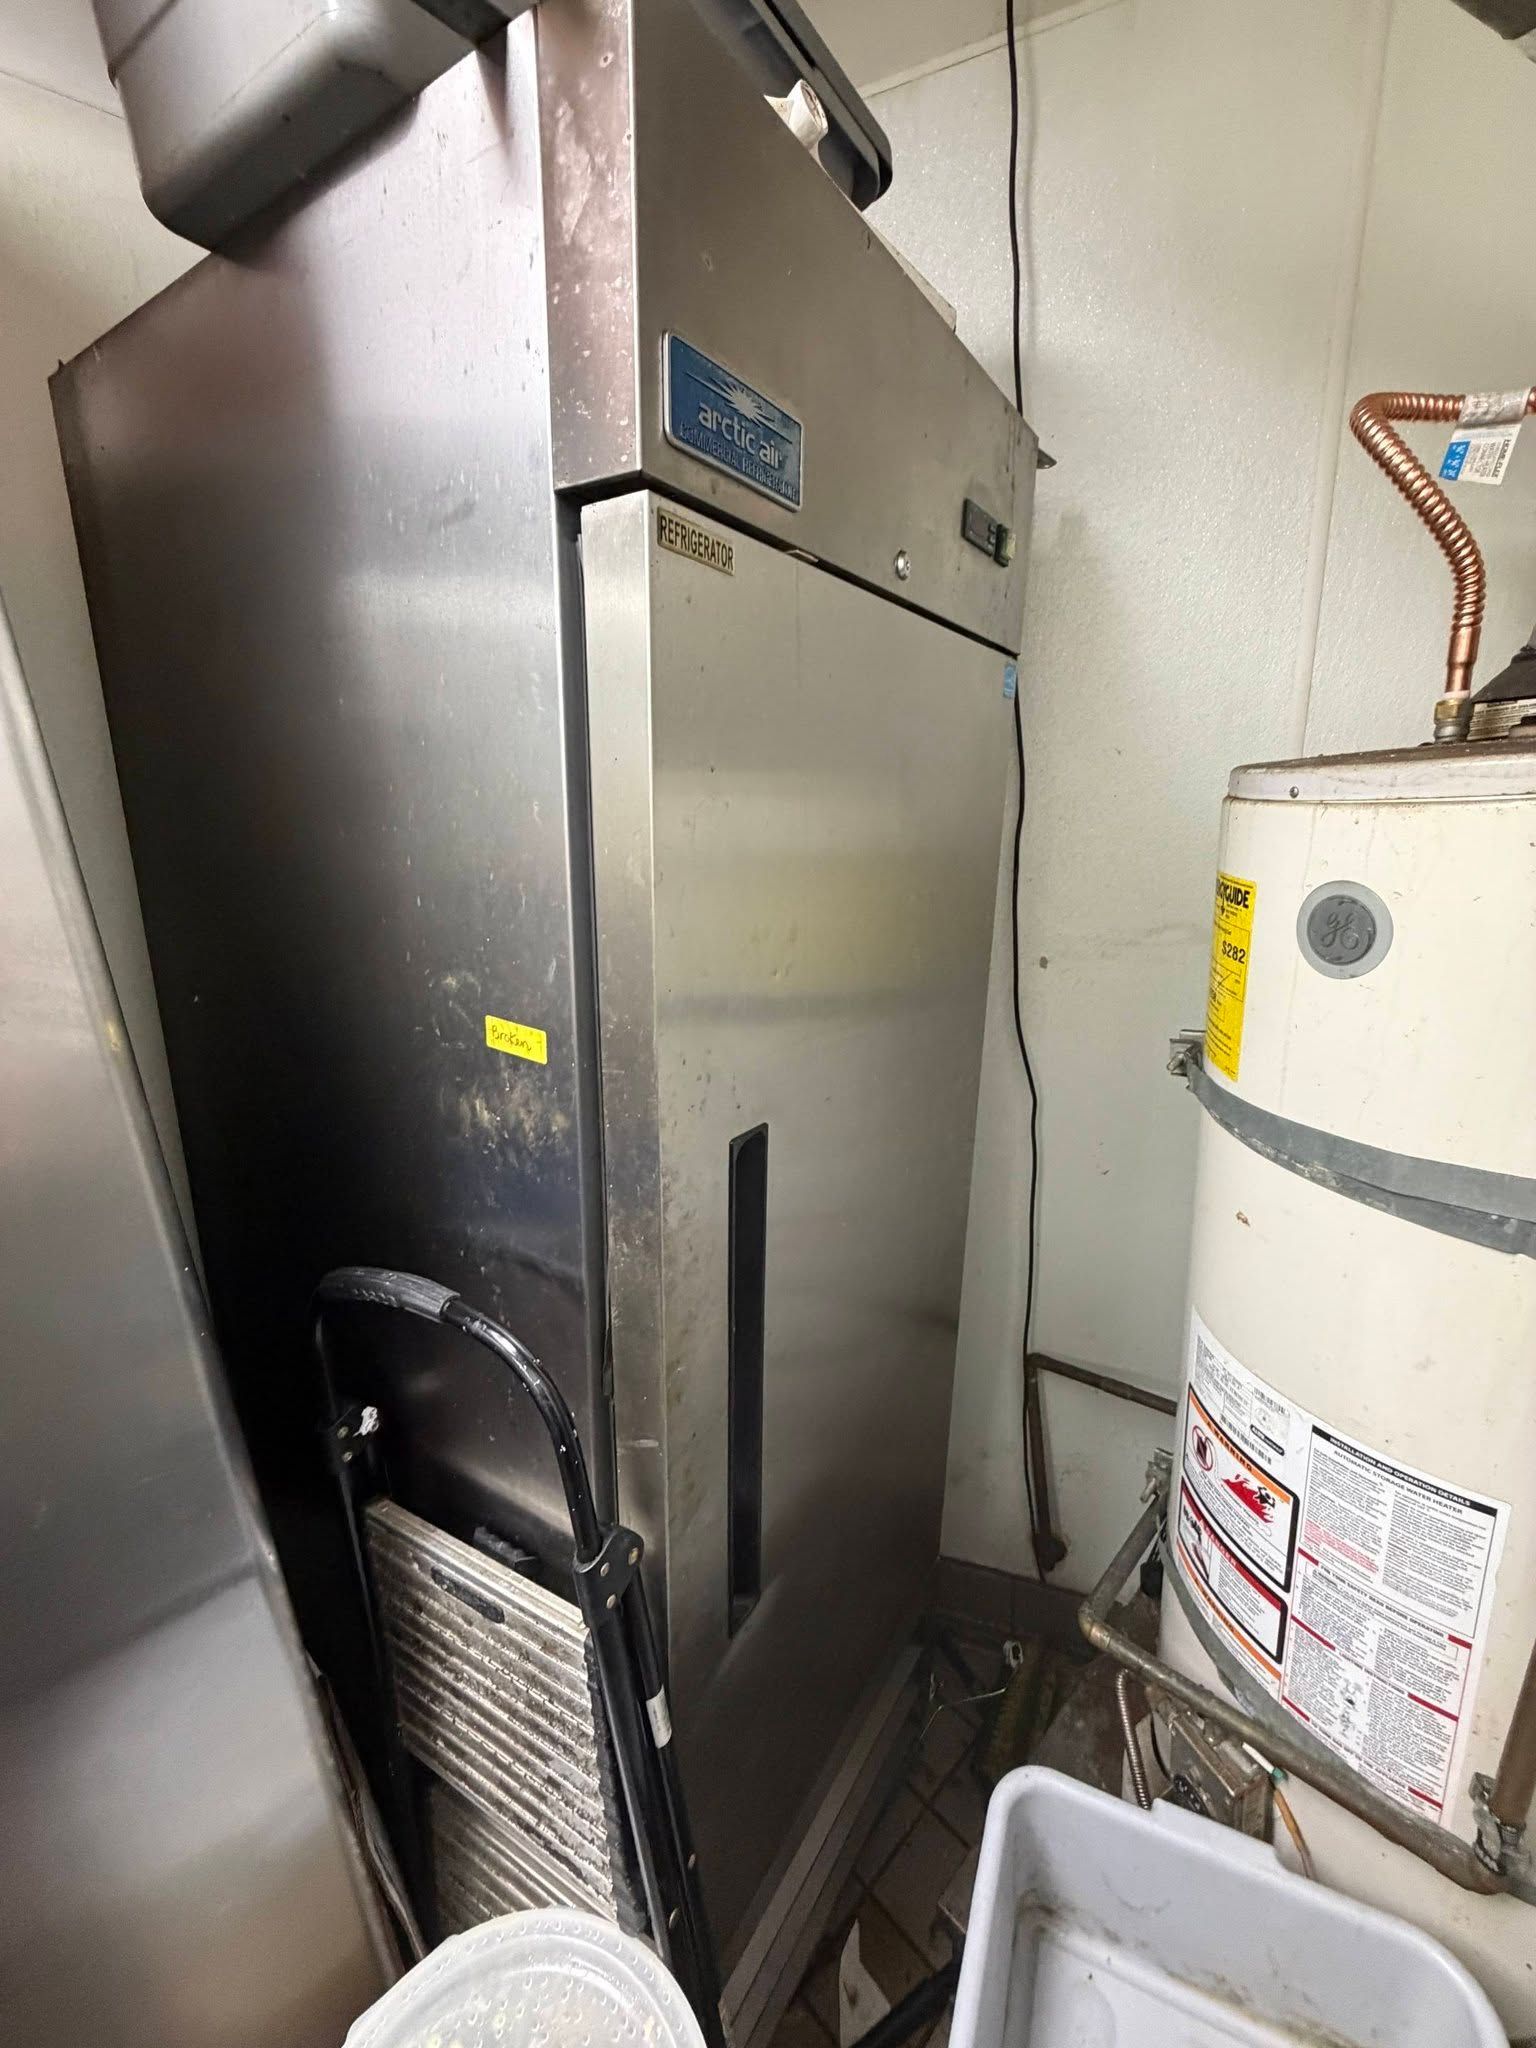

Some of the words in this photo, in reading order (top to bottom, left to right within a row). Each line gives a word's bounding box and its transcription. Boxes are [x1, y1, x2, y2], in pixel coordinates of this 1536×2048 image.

[699, 402, 756, 456] arctic
[759, 439, 783, 470] air
[660, 515, 733, 571] REFRIGERATOR
[1221, 940, 1246, 965] $282
[1329, 1437, 1377, 1466] INSTALLATION
[1376, 1462, 1394, 1474] AND
[1393, 1470, 1438, 1494] OPERATION
[1438, 1488, 1471, 1507] DETAILS
[1333, 1450, 1372, 1474] AUTOMATIC
[1372, 1471, 1405, 1490] STORAGE
[1406, 1485, 1432, 1502] WATER
[1432, 1498, 1463, 1515] HEATER
